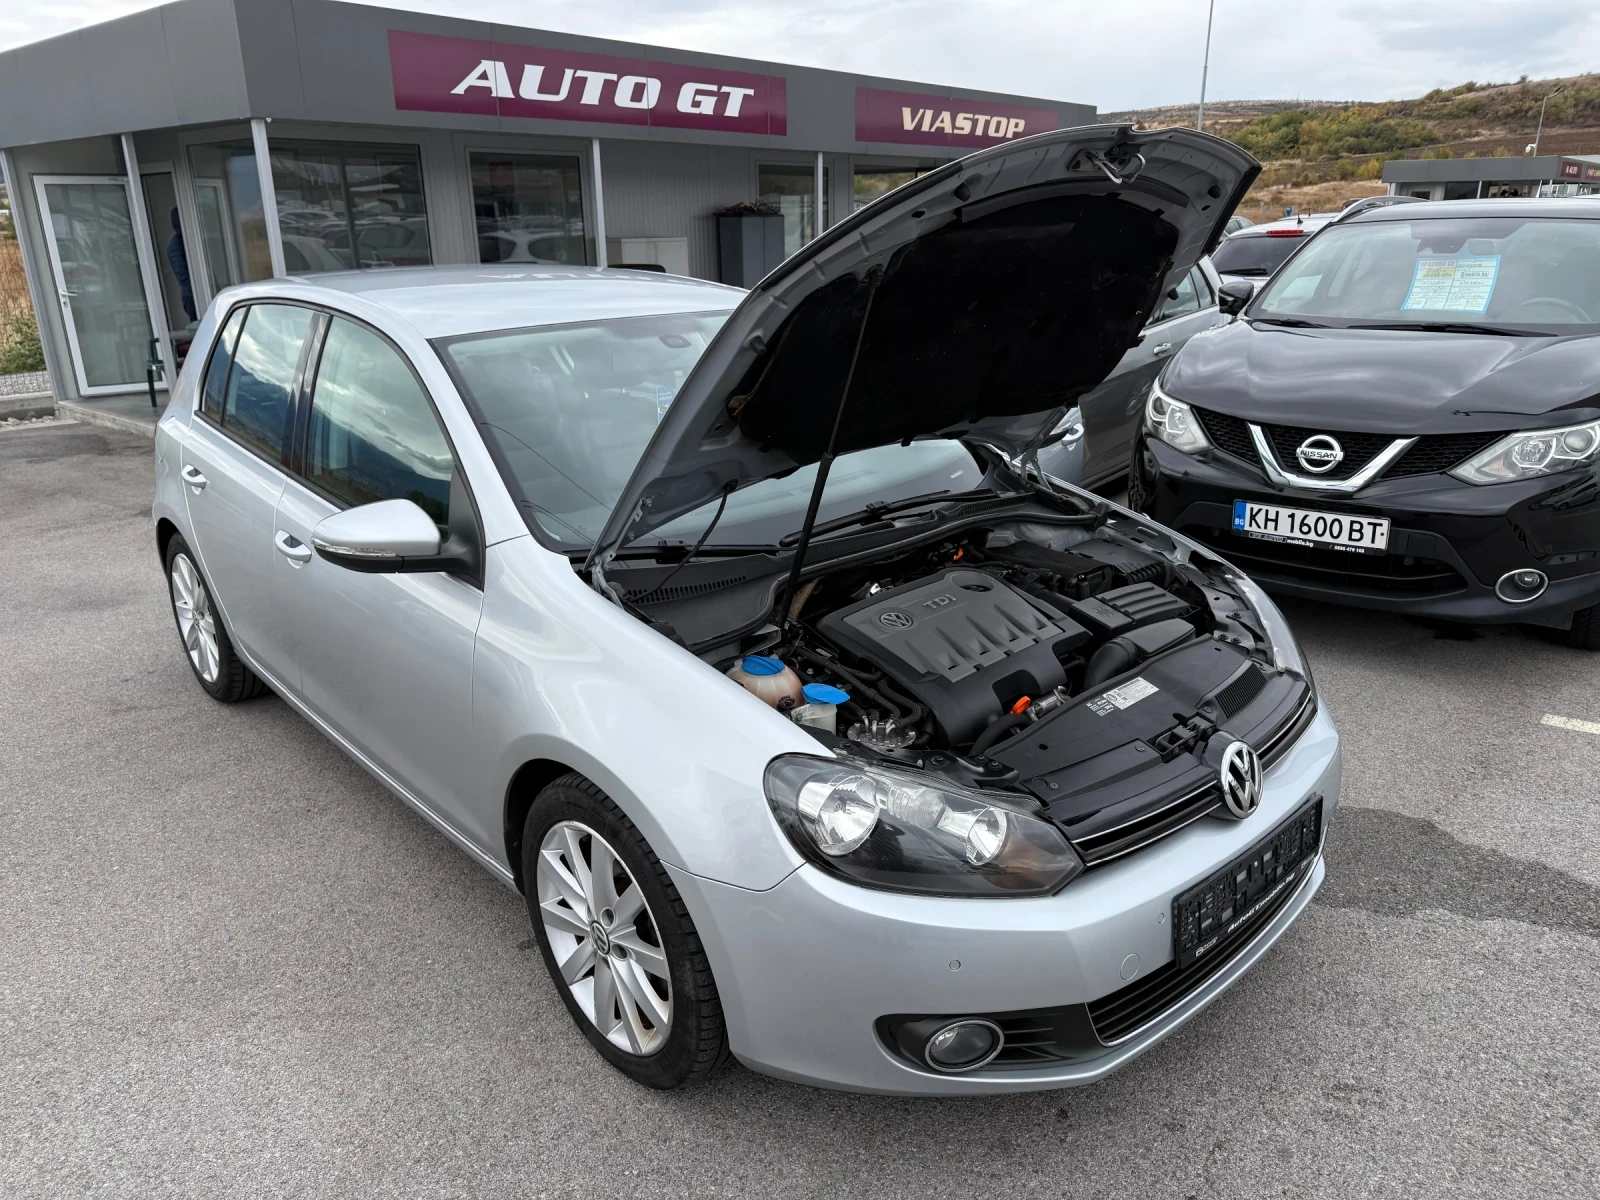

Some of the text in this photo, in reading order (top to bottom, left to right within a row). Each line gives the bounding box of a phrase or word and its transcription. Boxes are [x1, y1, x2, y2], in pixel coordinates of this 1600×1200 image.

[450, 59, 755, 118] AUTO GT
[901, 106, 1026, 139] VIASTOP
[1300, 449, 1338, 459] NISSAN
[1234, 517, 1245, 526] BG
[1248, 506, 1280, 532] KH
[1287, 512, 1343, 540] 1600
[1347, 519, 1383, 544] BT
[1286, 538, 1314, 548] mobile.bg
[921, 594, 957, 609] TDI
